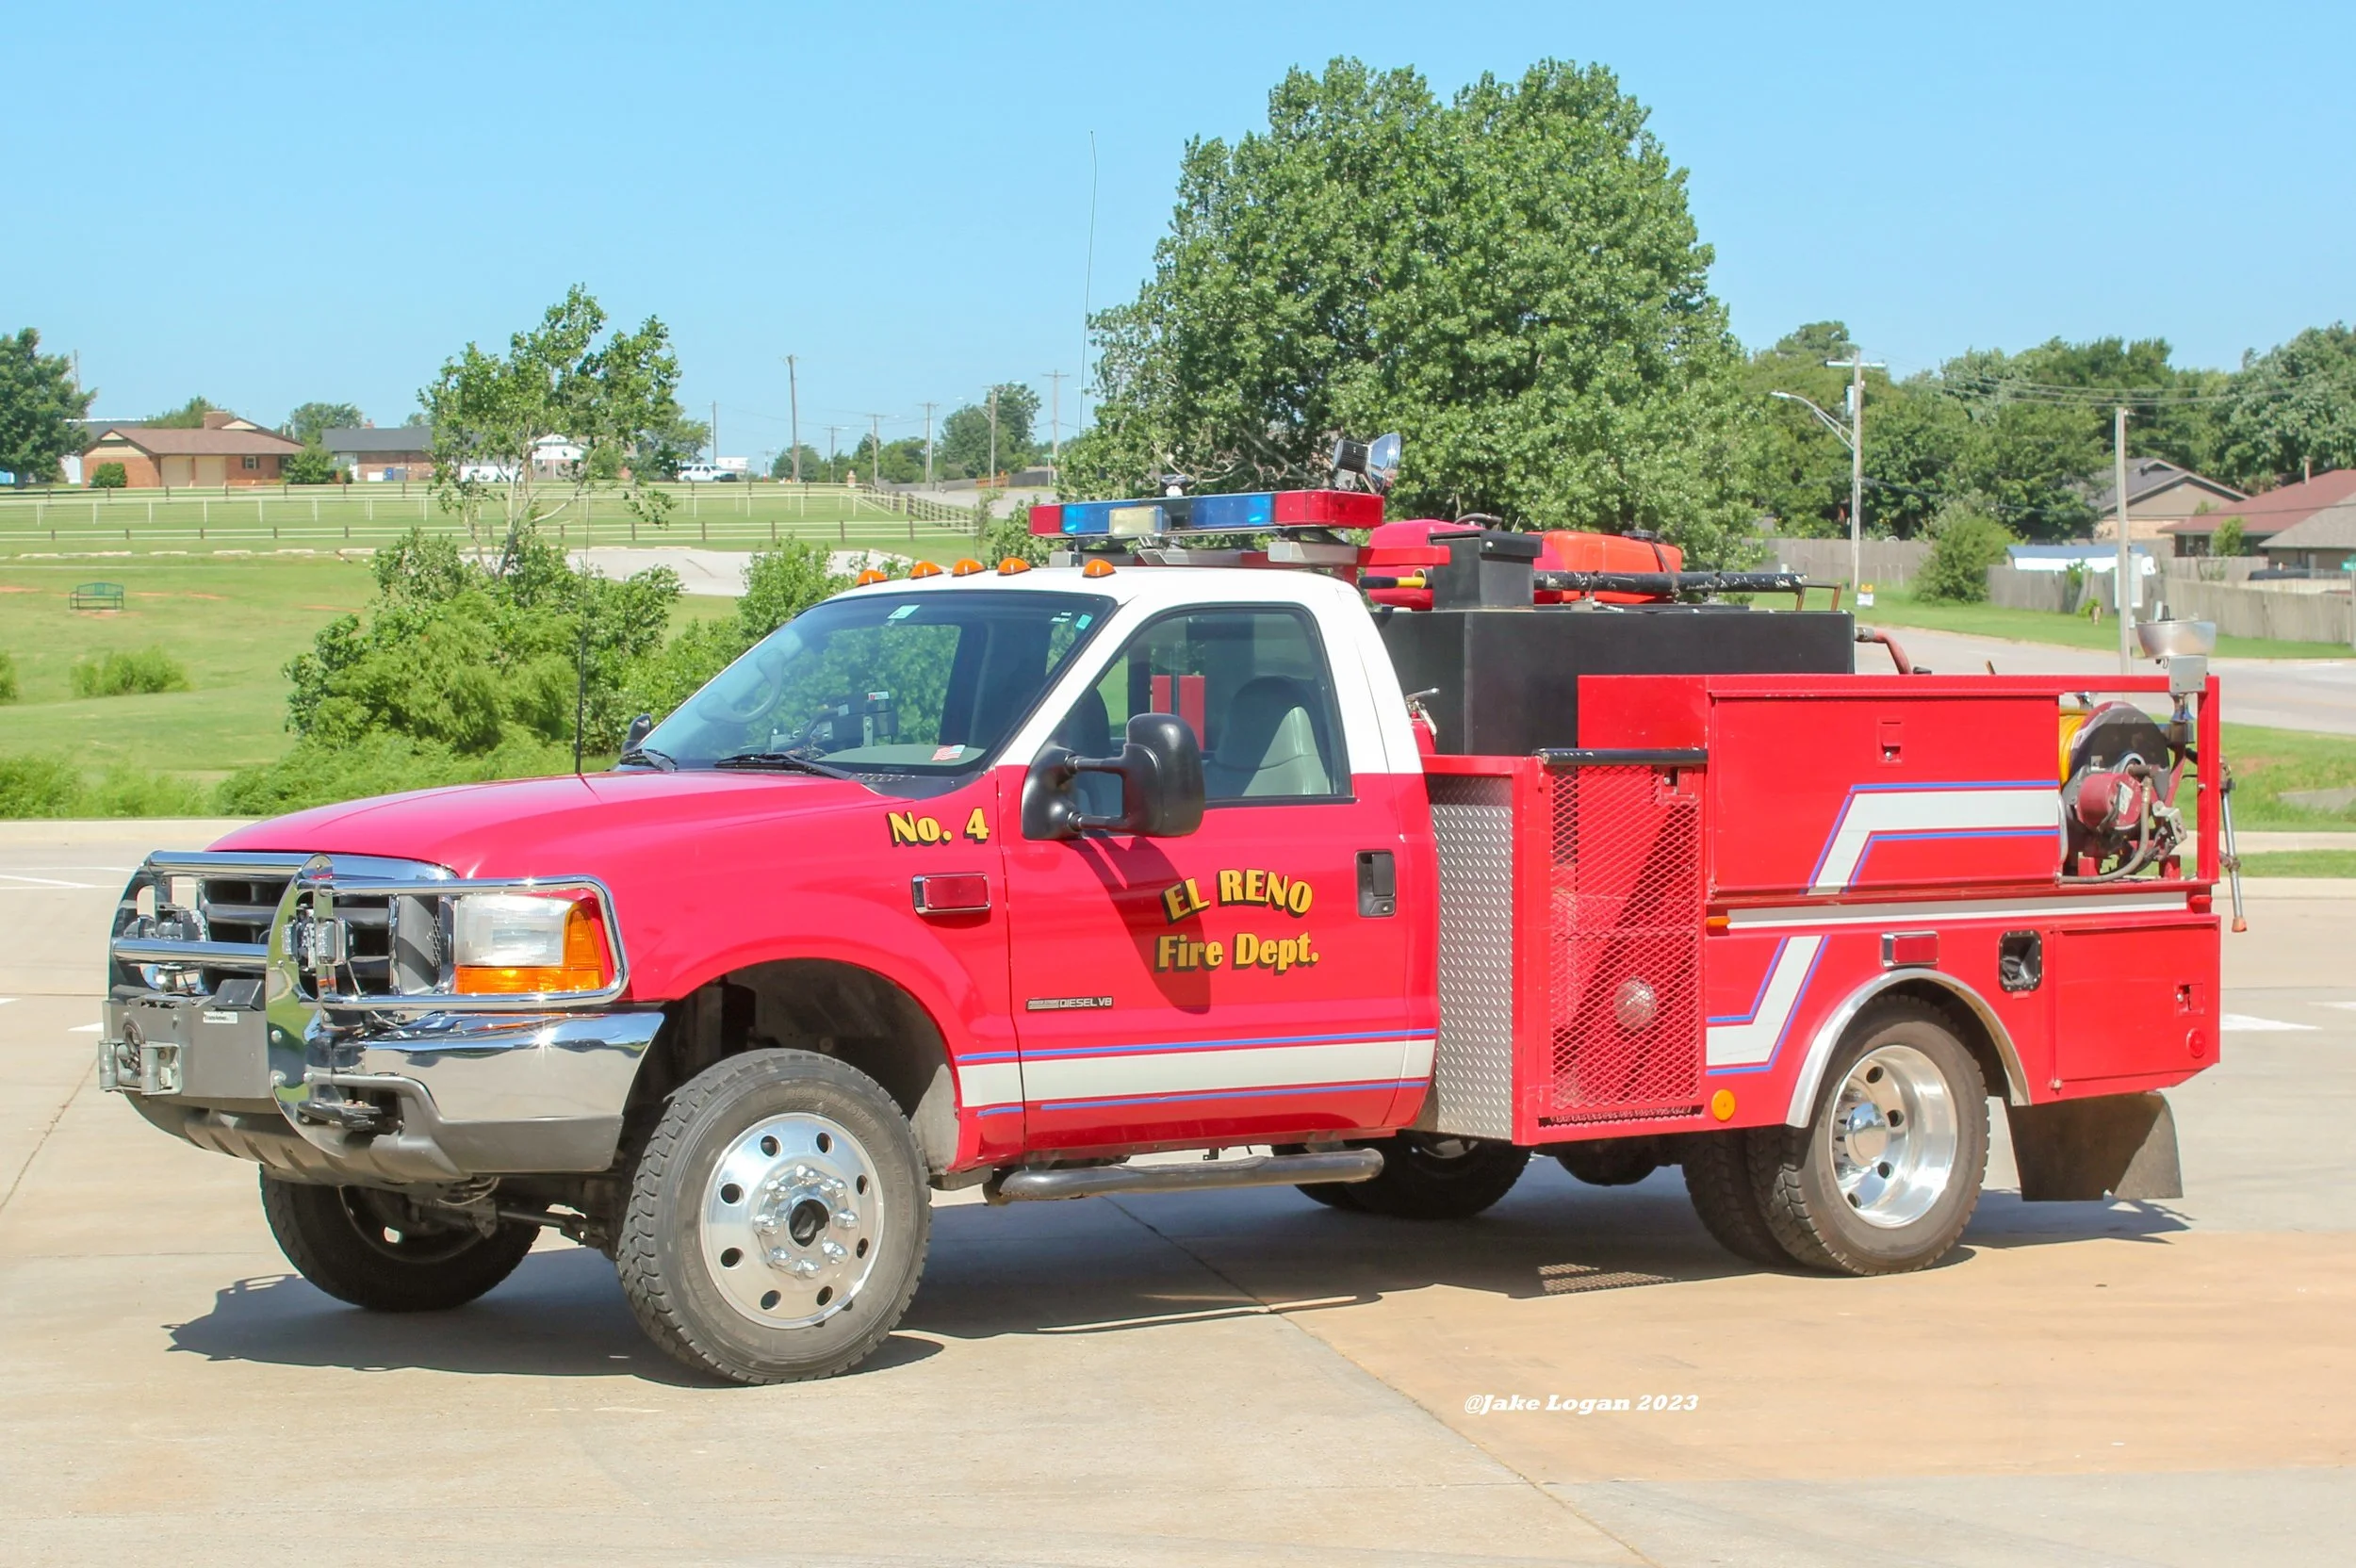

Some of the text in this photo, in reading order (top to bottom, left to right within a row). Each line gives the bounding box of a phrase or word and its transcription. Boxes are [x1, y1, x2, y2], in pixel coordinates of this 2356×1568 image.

[886, 807, 990, 847] No. 4
[1161, 868, 1314, 924] EL RENO
[1154, 931, 1319, 976] Fire Dept.
[1059, 998, 1097, 1008] DIESEL
[1098, 997, 1112, 1006] V8
